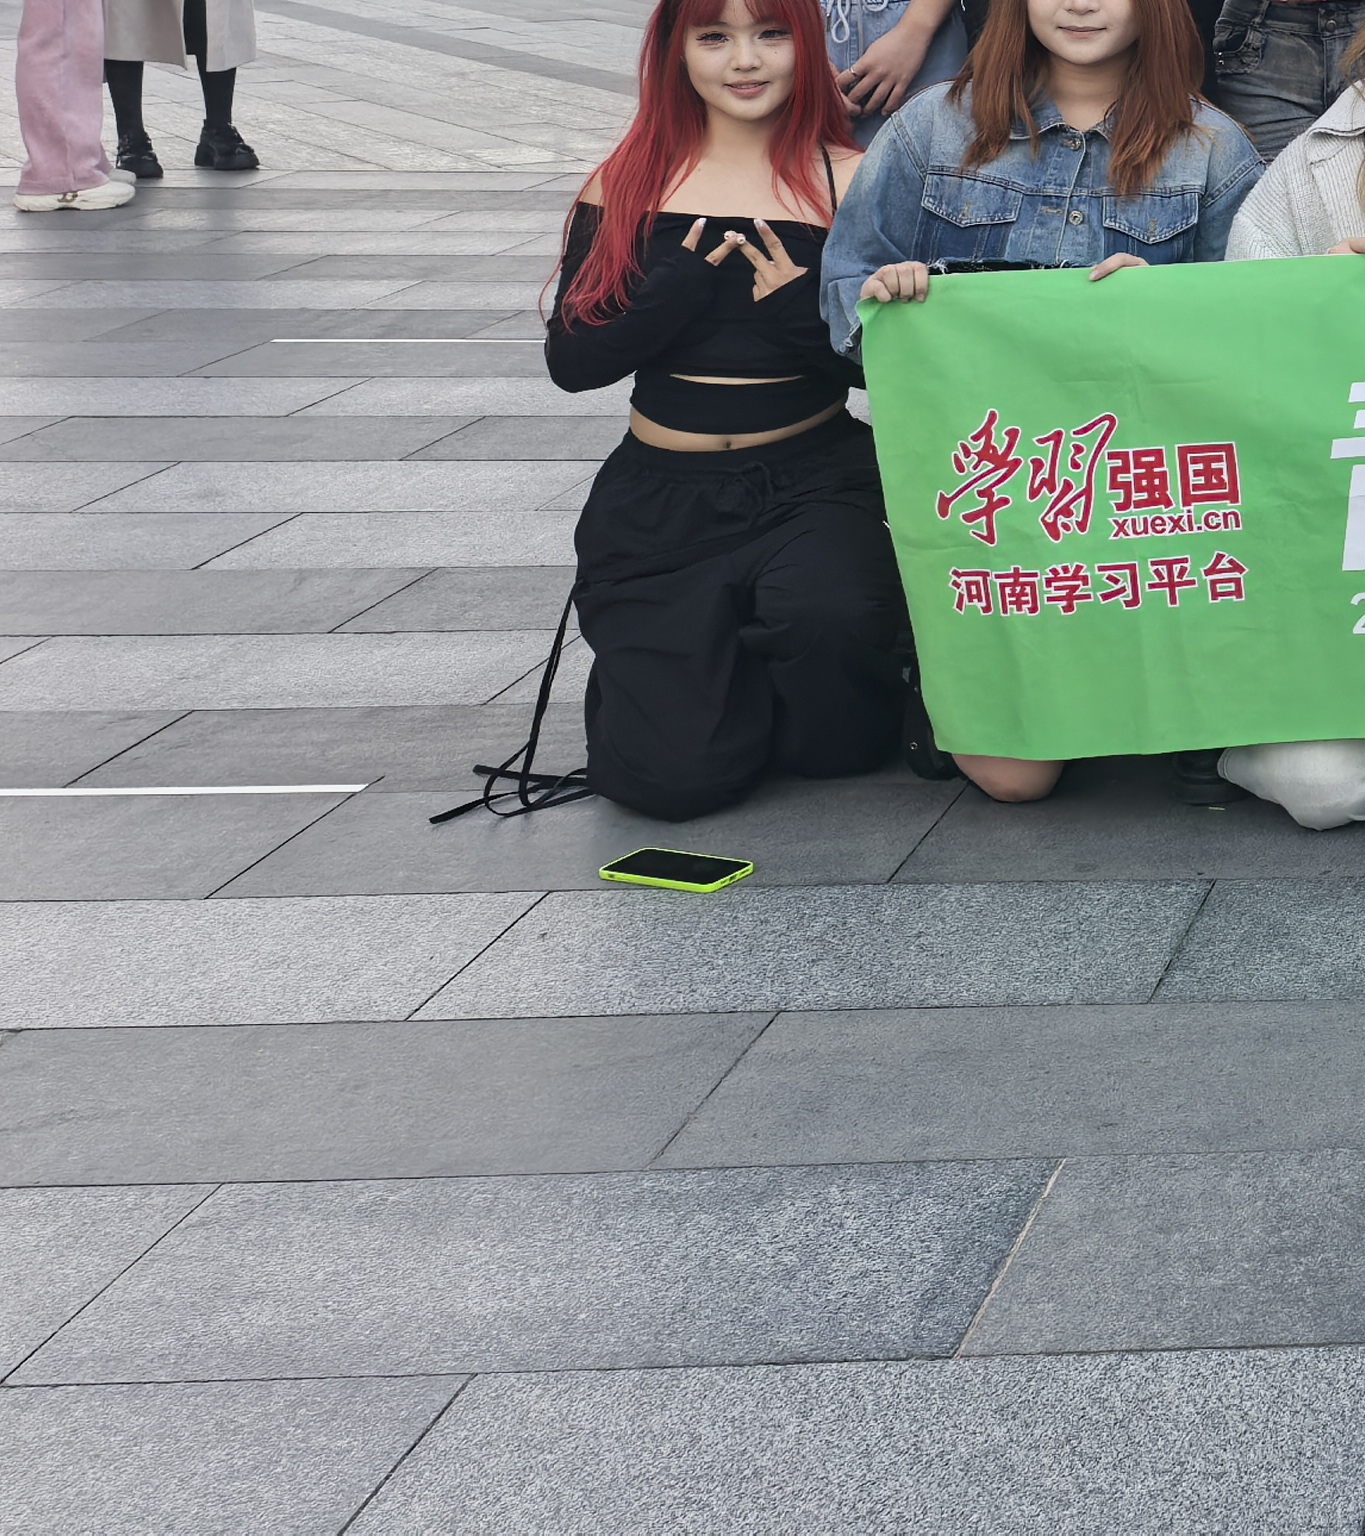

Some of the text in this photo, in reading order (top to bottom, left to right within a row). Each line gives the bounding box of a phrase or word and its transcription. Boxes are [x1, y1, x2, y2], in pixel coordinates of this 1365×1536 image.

[1107, 508, 1242, 541] xuexi.cn
[948, 550, 1249, 617] 河南学习平台
